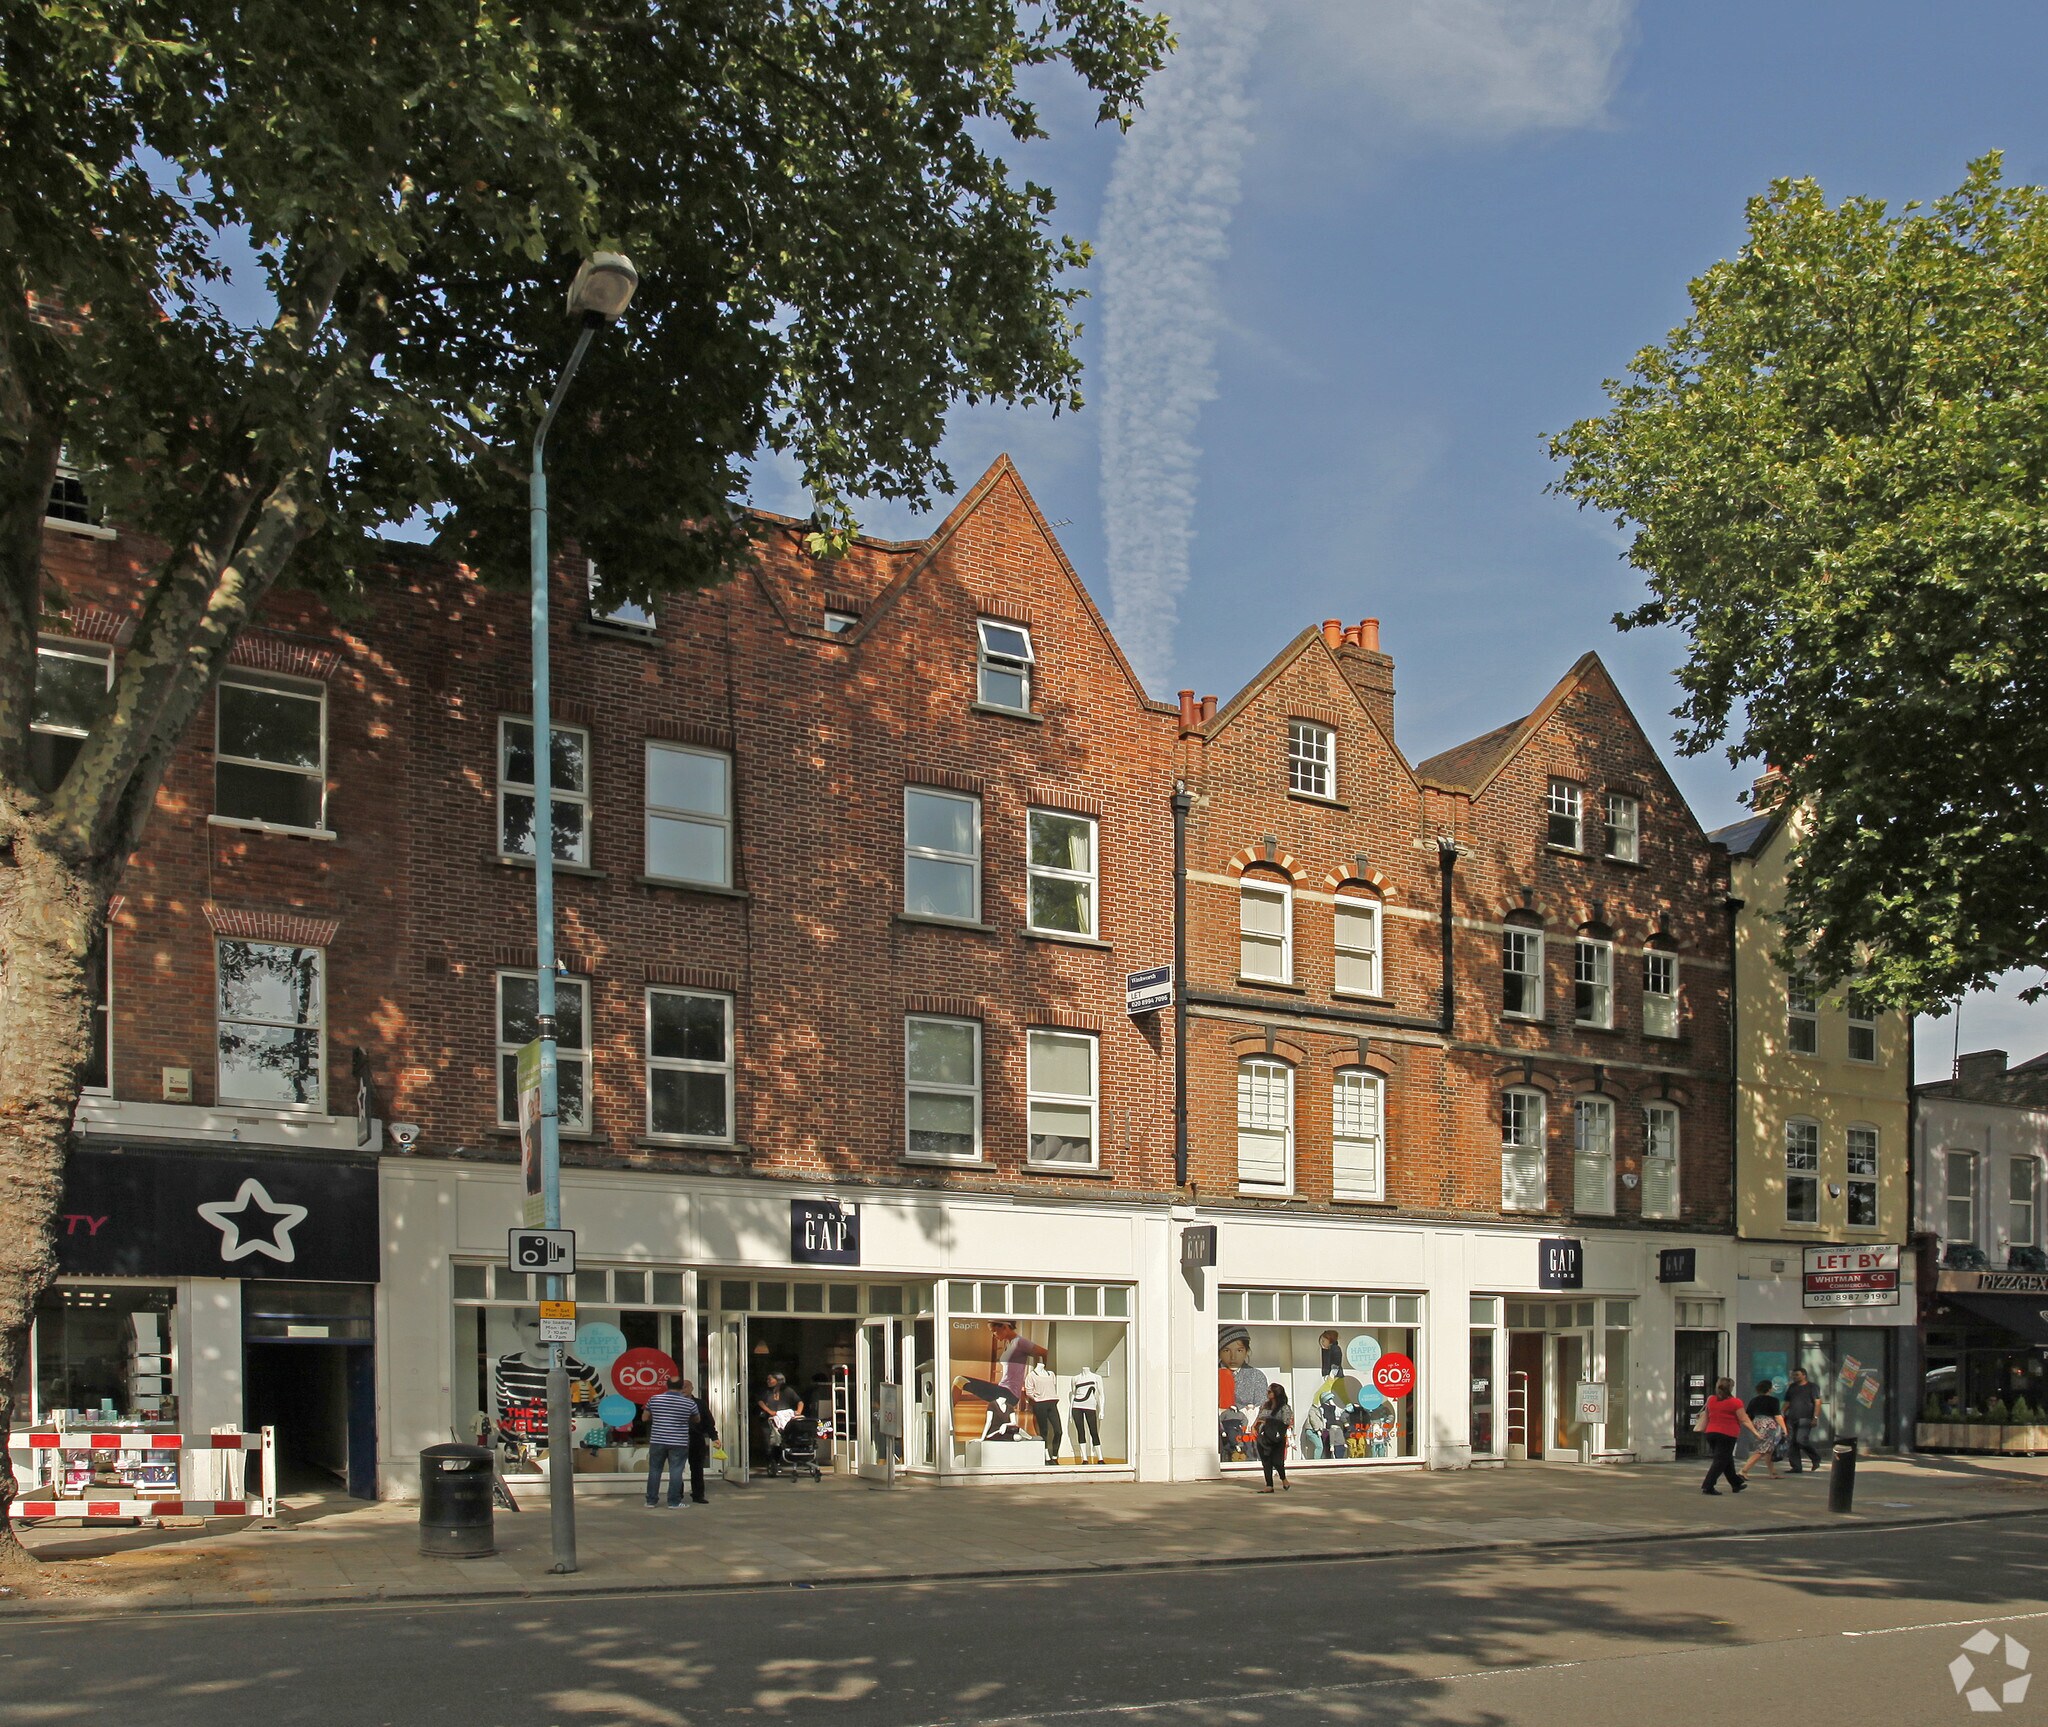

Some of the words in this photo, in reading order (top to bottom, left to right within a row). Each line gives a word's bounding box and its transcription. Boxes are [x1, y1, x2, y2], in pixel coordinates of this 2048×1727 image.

[1131, 991, 1142, 999] LET
[805, 1211, 847, 1222] baby
[805, 1220, 847, 1251] GAP
[1550, 1249, 1575, 1271] GAP
[1817, 1255, 1851, 1269] LET
[1858, 1253, 1885, 1268] BY
[1815, 1275, 1861, 1284] WHITMAN
[579, 1336, 620, 1345] HAPPY
[579, 1346, 620, 1355] LITTLE
[507, 1407, 535, 1418] THE
